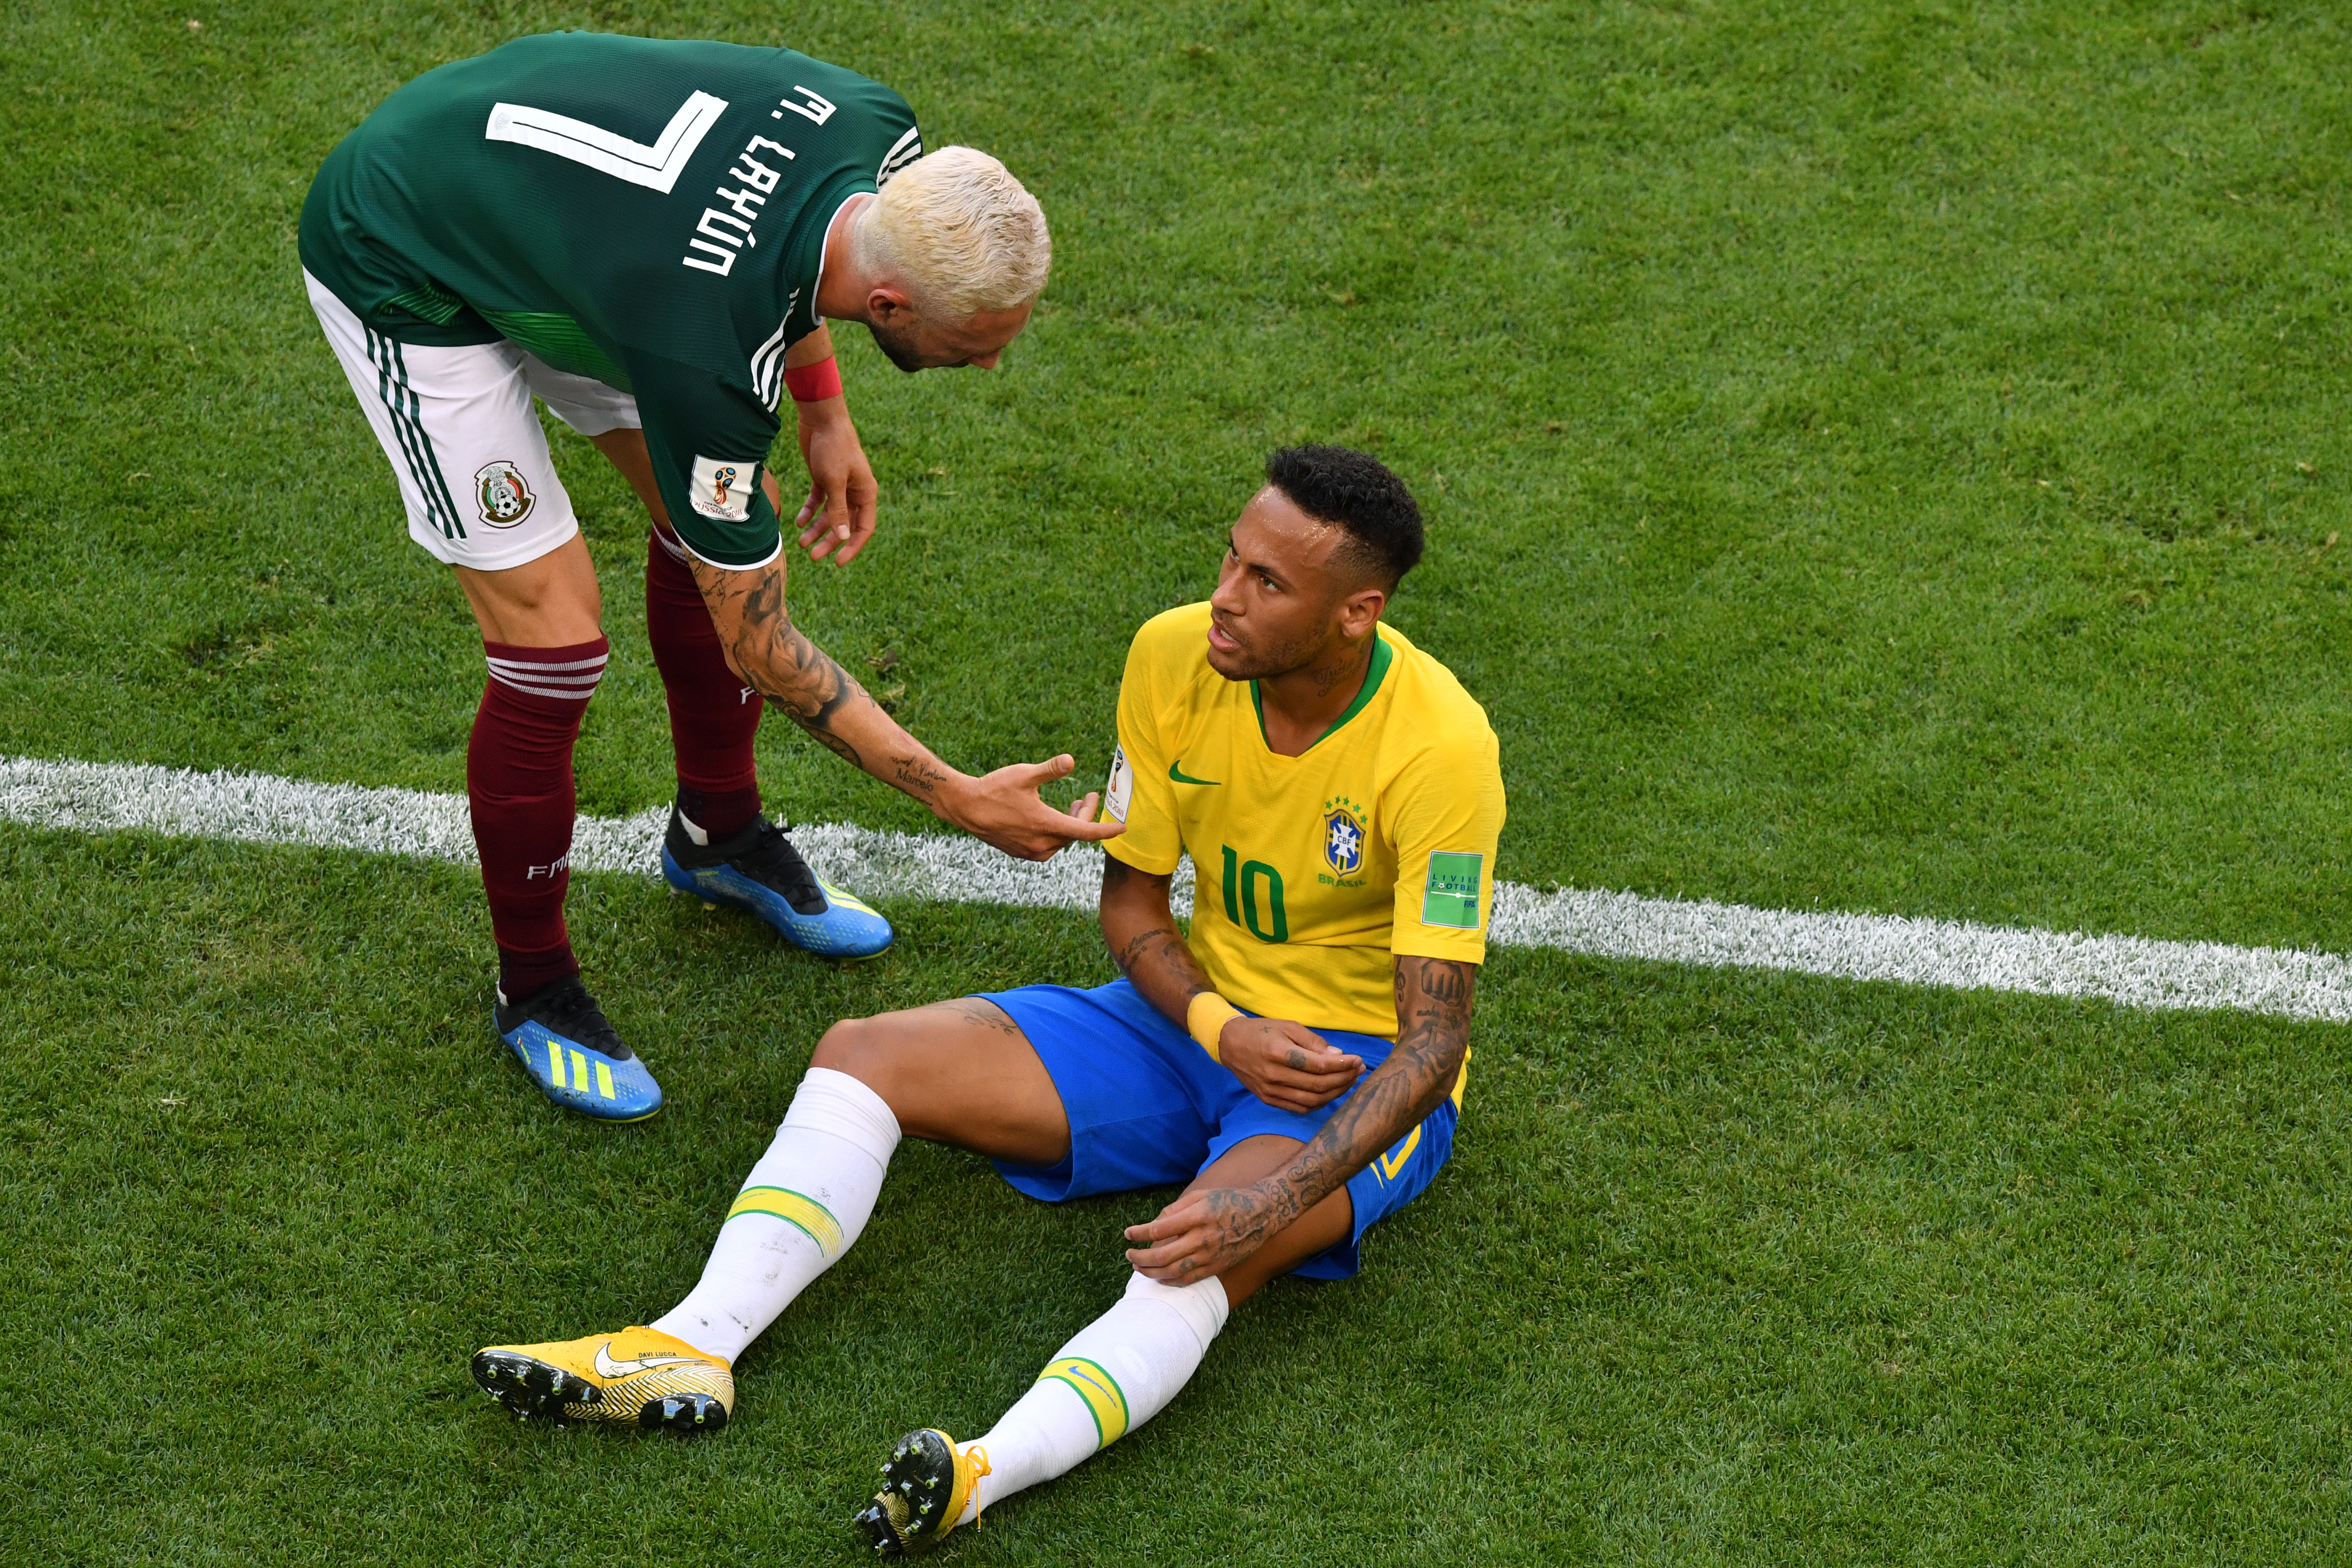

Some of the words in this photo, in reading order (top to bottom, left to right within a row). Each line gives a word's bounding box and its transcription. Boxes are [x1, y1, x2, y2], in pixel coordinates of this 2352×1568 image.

[771, 85, 837, 126] M.
[486, 89, 729, 194] 7
[682, 135, 796, 277] LAYÚN
[896, 768, 934, 792] Marcelo
[1337, 835, 1351, 846] CBF
[1318, 873, 1367, 887] BRASIL
[1433, 873, 1477, 884] LIVING
[1221, 844, 1289, 943] 10
[1464, 900, 1475, 908] FIFA
